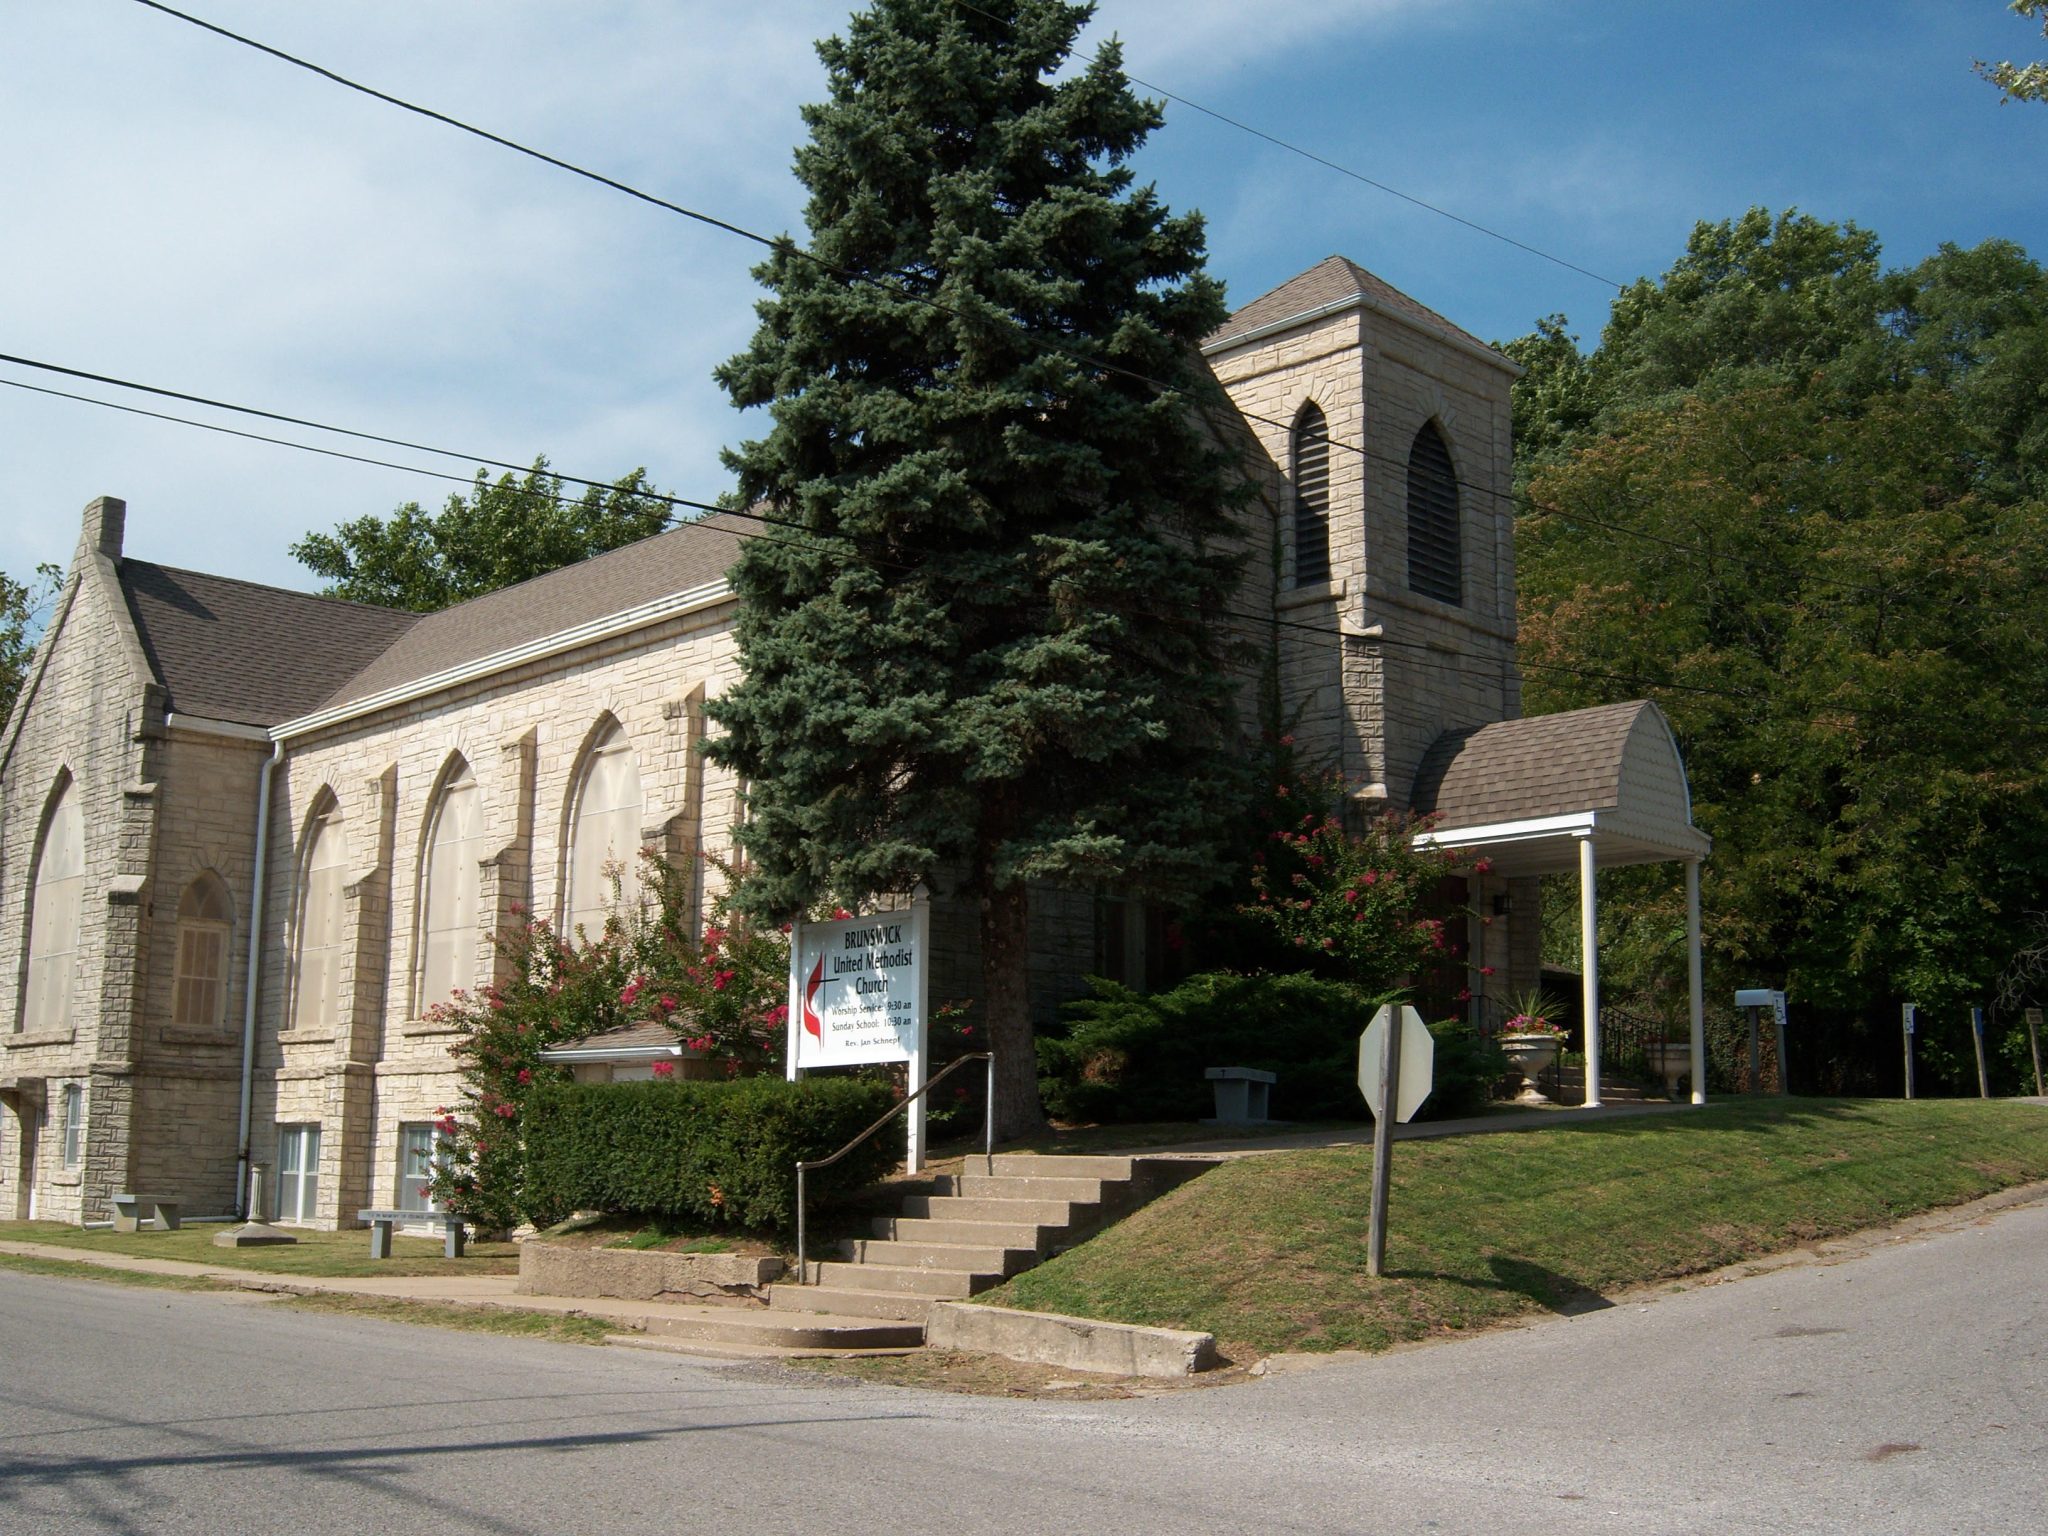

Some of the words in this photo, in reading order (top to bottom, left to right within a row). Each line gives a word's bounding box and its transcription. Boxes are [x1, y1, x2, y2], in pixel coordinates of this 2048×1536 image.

[845, 925, 902, 949] BRUNSWICK
[834, 954, 863, 974] United
[866, 948, 912, 971] Methodist
[856, 974, 889, 995] Church
[832, 1005, 858, 1016] Worship
[887, 1000, 902, 1011] 9:30
[832, 1021, 854, 1032] Sunday
[856, 1019, 880, 1030] School:
[884, 1017, 902, 1027] 10:30
[861, 1039, 871, 1047] Jan
